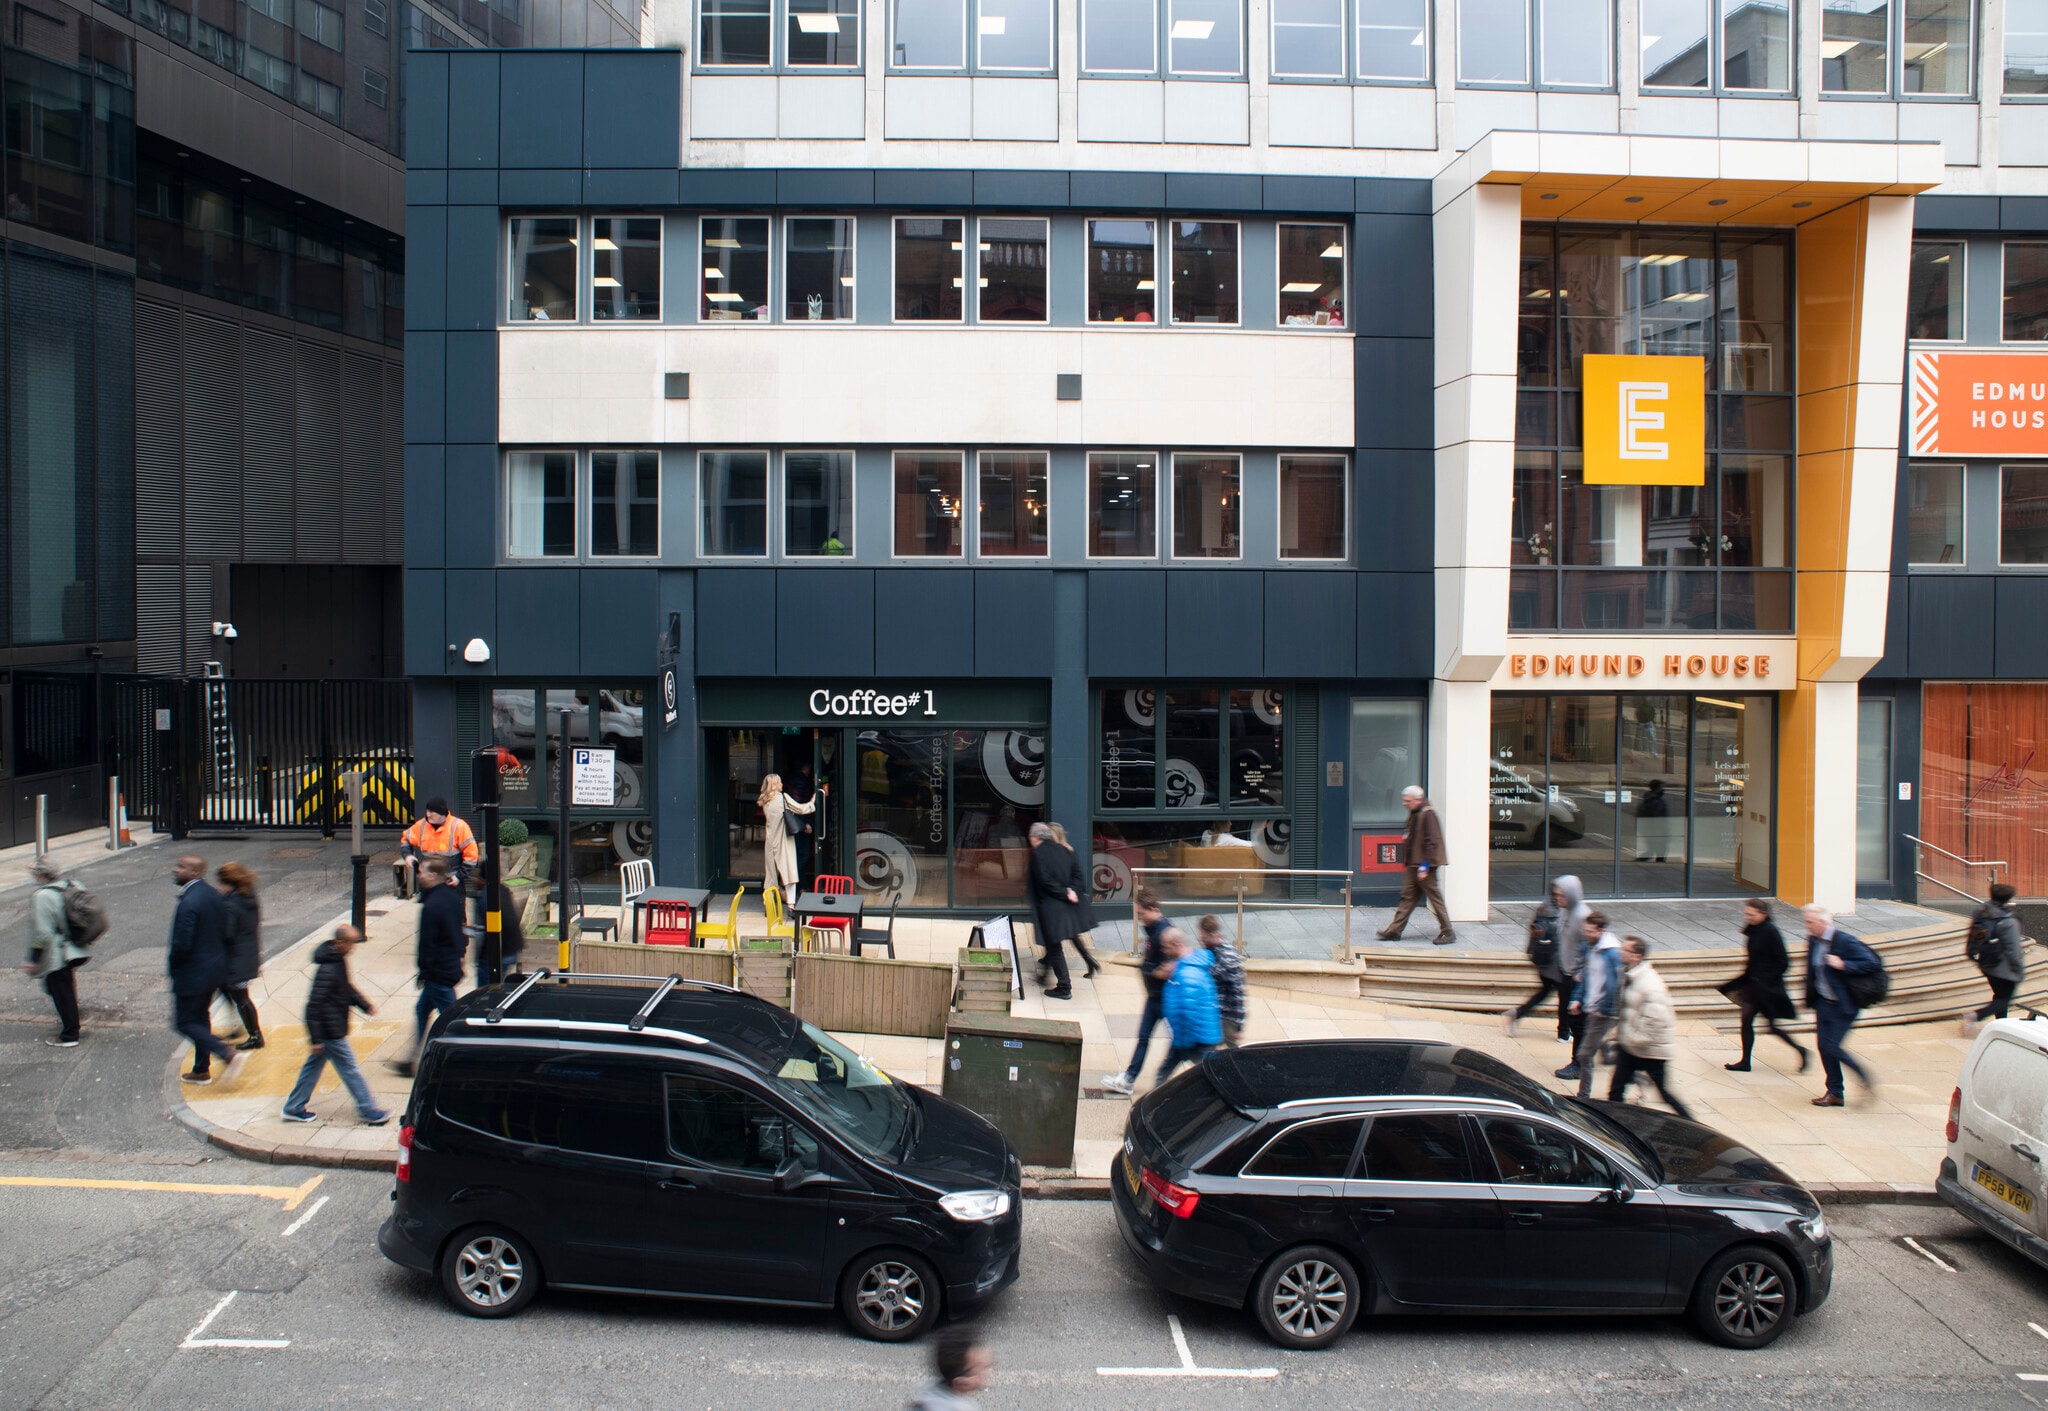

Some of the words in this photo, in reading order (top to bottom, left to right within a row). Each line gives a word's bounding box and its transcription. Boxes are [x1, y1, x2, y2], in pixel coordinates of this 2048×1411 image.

[1972, 382, 2046, 401] EDMU
[1619, 381, 1669, 460] E
[1972, 410, 2045, 429] HOUS
[1511, 654, 1645, 676] EDMUND
[1664, 654, 1770, 676] HOUSE
[809, 689, 937, 716] Coffee#1
[579, 751, 588, 764] P
[930, 738, 943, 790] House
[1105, 729, 1120, 802] Coffee#1
[1497, 763, 1516, 771] Your
[1714, 771, 1750, 782] planning
[1719, 782, 1731, 790] for
[1516, 785, 1532, 793] had
[930, 794, 943, 843] Coffee
[2008, 1188, 2030, 1211] VGN
